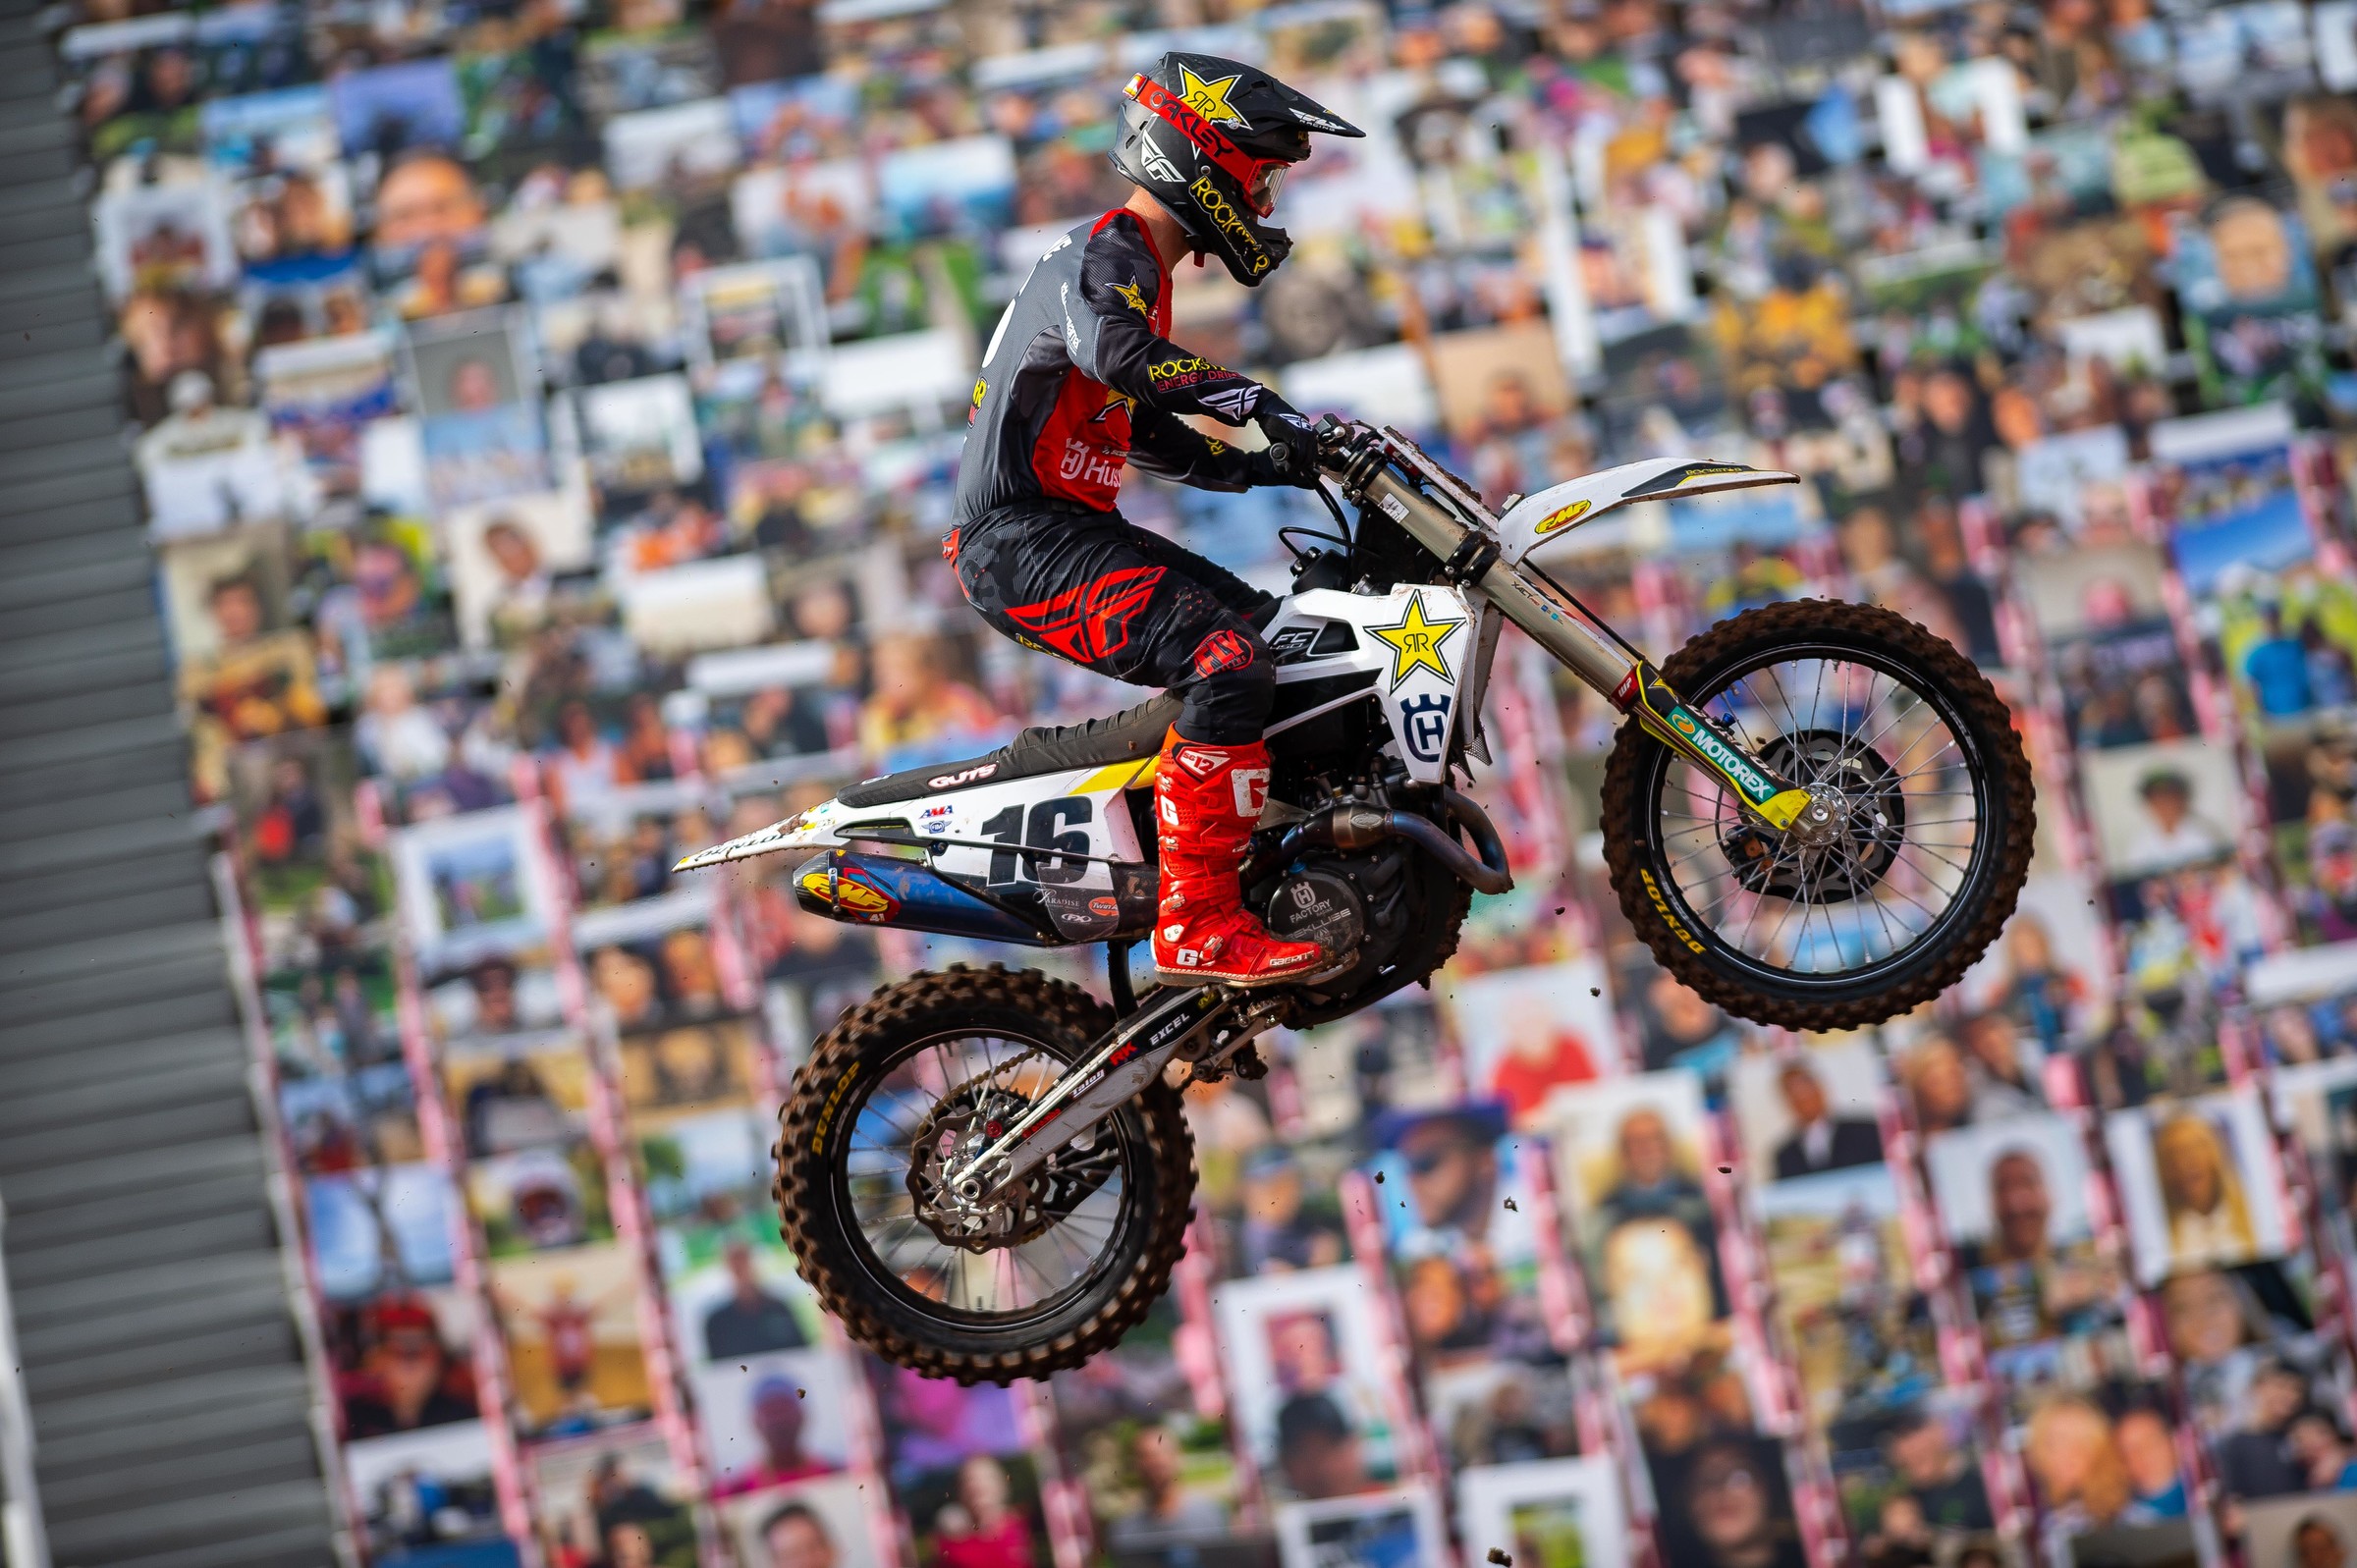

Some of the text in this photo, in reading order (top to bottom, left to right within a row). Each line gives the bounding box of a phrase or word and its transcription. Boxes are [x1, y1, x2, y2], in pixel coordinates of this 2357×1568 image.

[1150, 91, 1233, 157] OAKLEY
[1147, 357, 1227, 382] ROCKS
[1157, 373, 1203, 392] ENERGY
[1537, 500, 1591, 534] FMF
[1194, 629, 1243, 677] FLY
[1274, 631, 1313, 645] FC
[928, 763, 998, 789] GUTS
[1691, 729, 1771, 799] MOTOREX
[919, 804, 954, 819] AMA
[980, 795, 1093, 886] 16
[802, 873, 889, 907] FMF
[1092, 901, 1111, 910] Twin
[1289, 898, 1332, 923] FACTORY
[1640, 868, 1707, 954] DUNLOP
[1148, 1012, 1191, 1046] EXCEL
[1109, 1041, 1138, 1066] RK
[811, 1060, 861, 1157] DUNLOP
